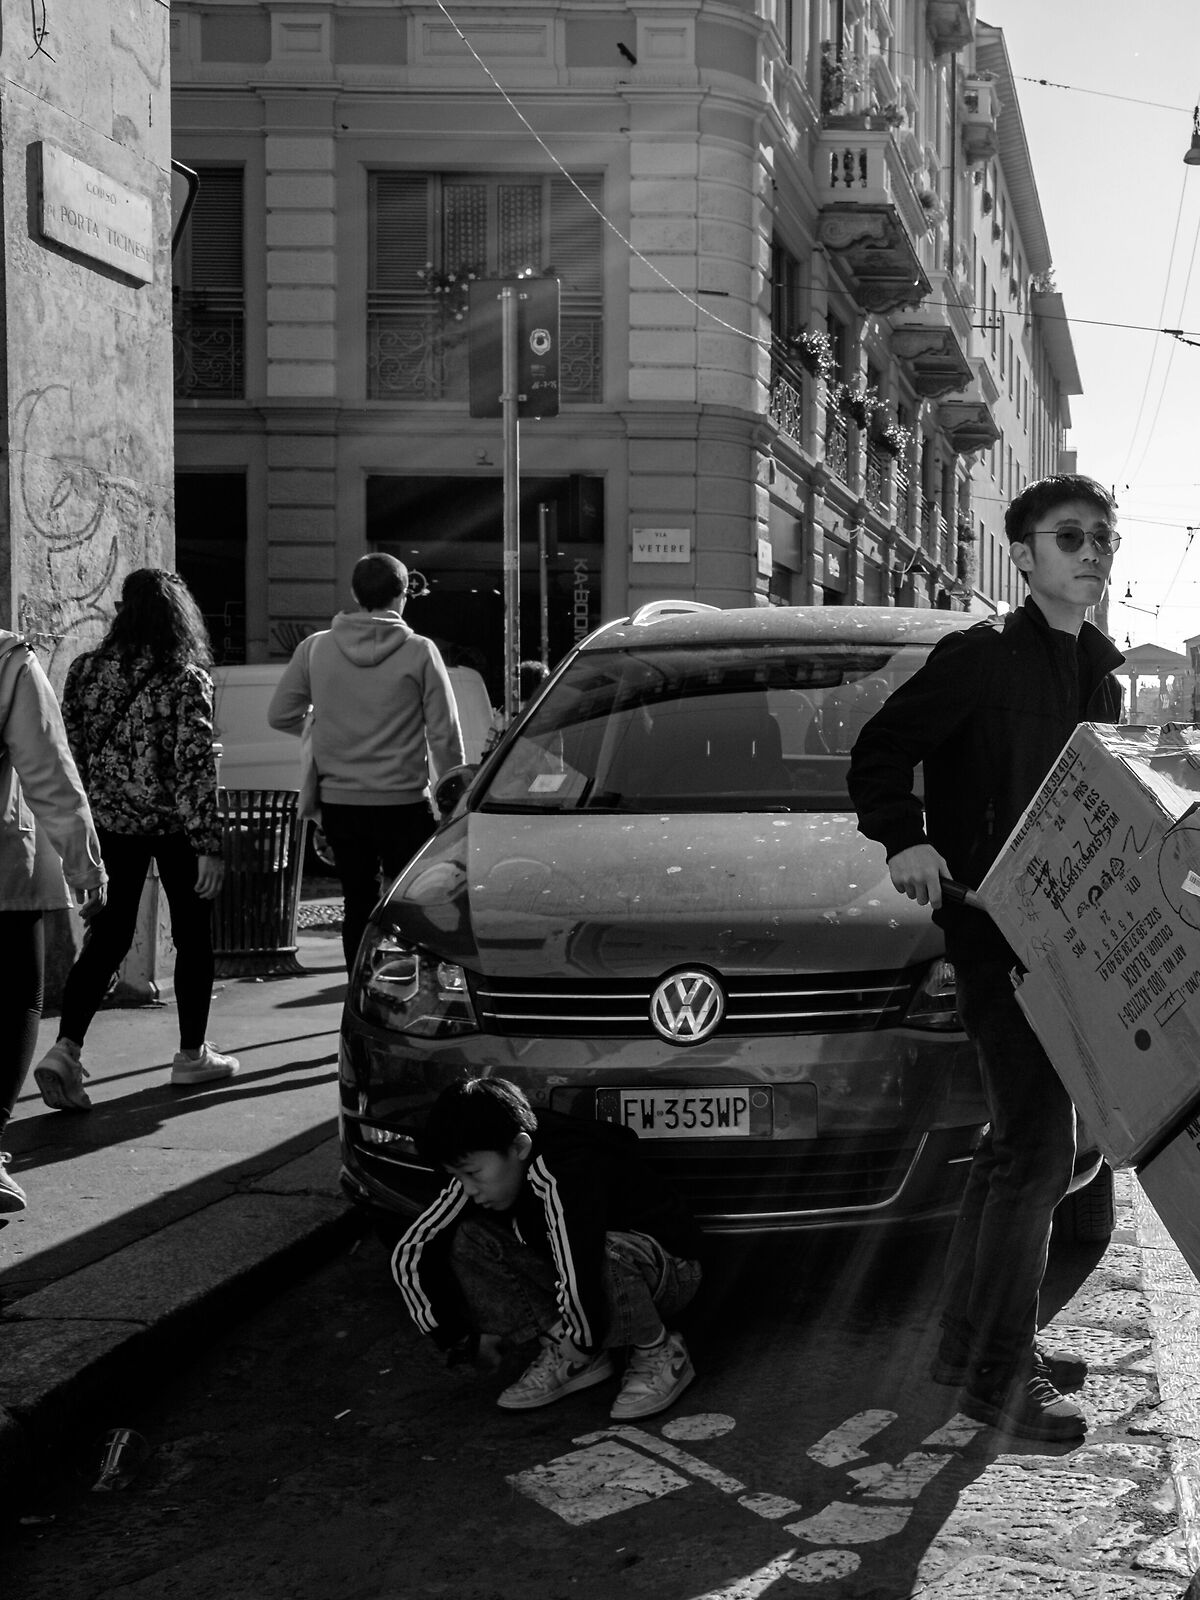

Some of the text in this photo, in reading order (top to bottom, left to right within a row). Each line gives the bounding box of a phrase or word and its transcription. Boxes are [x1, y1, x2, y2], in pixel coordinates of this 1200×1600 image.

[86, 182, 116, 204] CORSO
[60, 205, 99, 239] PORTA
[106, 226, 151, 263] TICINESE
[639, 544, 684, 553] VETERE
[1033, 795, 1044, 810] 37
[1040, 783, 1052, 798] 38
[1047, 770, 1060, 787] 39
[1056, 757, 1069, 772] 40
[1065, 745, 1076, 759] 41
[1082, 788, 1099, 811] KGS
[1026, 780, 1088, 876] QTY: 24 PRS
[1071, 875, 1141, 958] QTY: 24 PRS
[1099, 906, 1161, 981] SIZE: 36 37 38 39 40 41
[1144, 924, 1173, 956] COLOUR:
[1171, 944, 1186, 964] ART
[1120, 950, 1151, 989] BLACK
